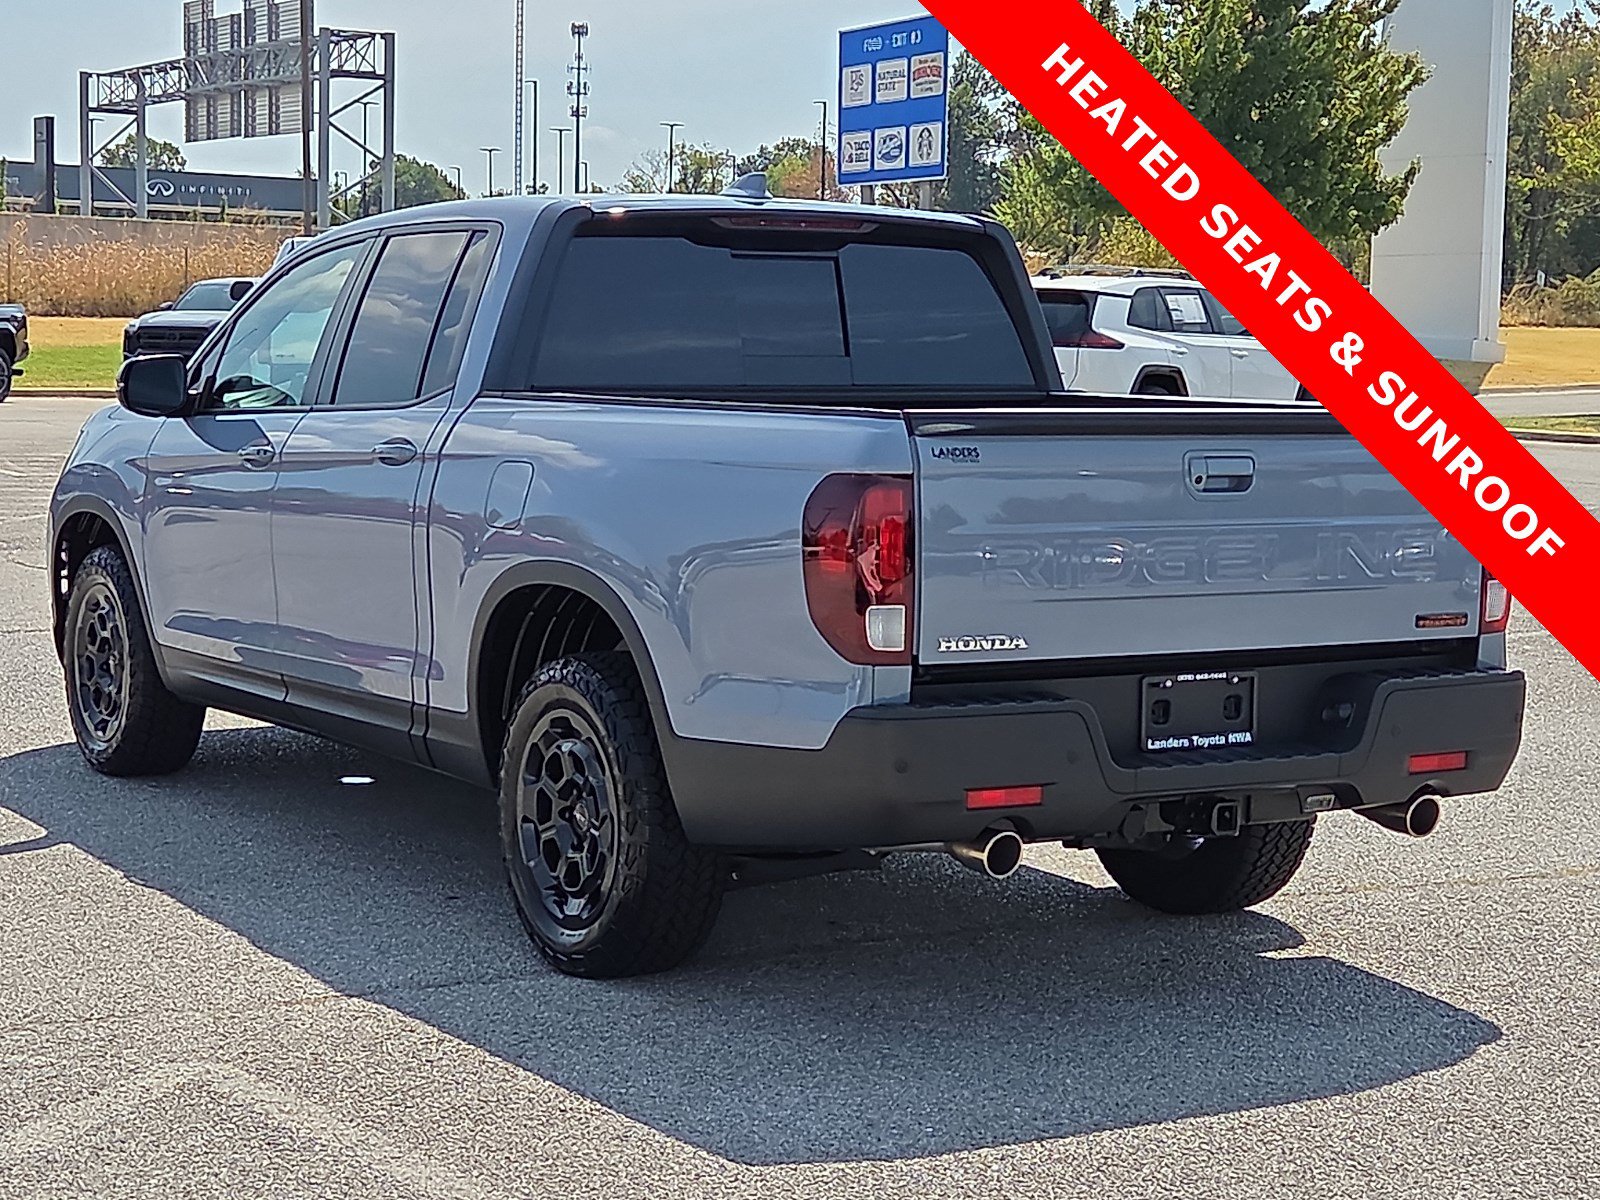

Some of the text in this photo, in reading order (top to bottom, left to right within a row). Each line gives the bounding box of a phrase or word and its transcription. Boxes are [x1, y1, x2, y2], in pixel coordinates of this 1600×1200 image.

[181, 184, 252, 195] INFINITI
[931, 446, 980, 459] LANDERS
[980, 528, 1438, 590] RIDGELINE
[937, 634, 1028, 652] HONDA
[1147, 736, 1190, 750] Landers
[1191, 734, 1226, 748] Toyota
